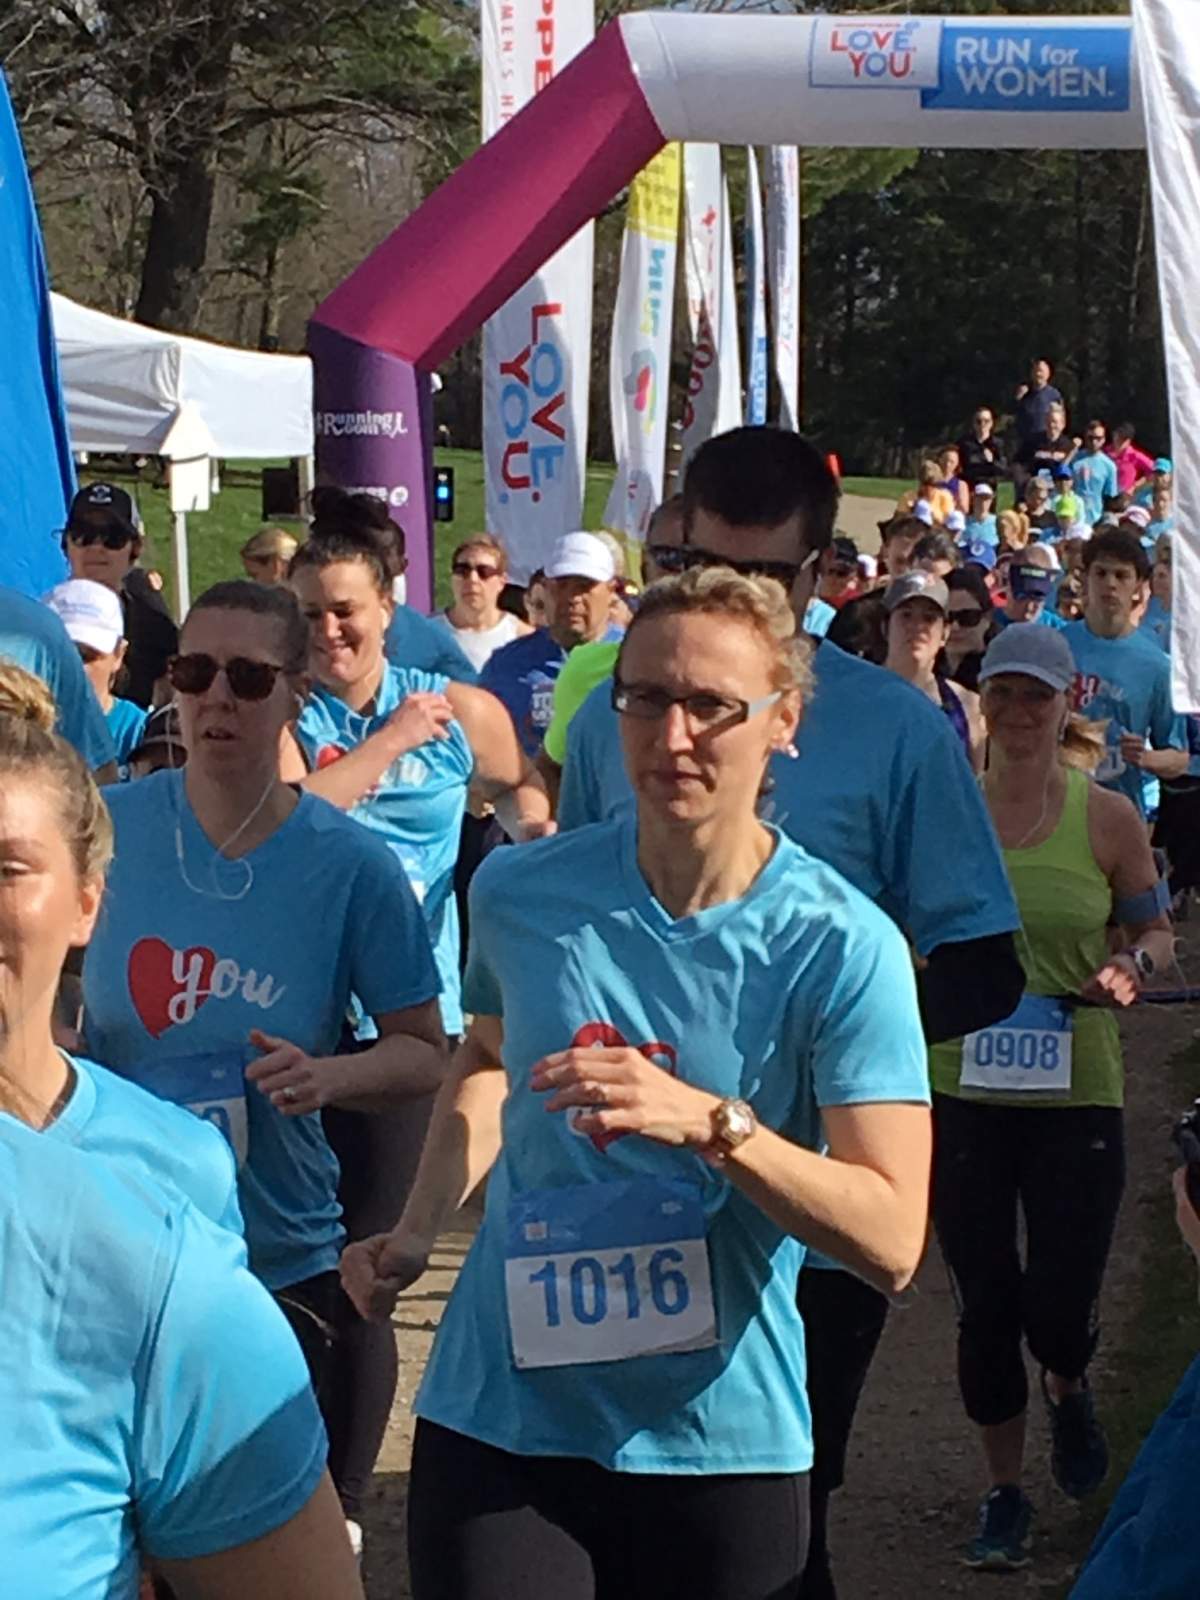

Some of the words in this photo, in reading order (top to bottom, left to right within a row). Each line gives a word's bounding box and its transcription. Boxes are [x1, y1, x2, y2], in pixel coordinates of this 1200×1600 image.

[955, 36, 1031, 65] RUN
[1040, 44, 1079, 65] for
[168, 949, 287, 1024] you
[974, 1031, 1059, 1071] 0908
[529, 1248, 690, 1327] 1016
